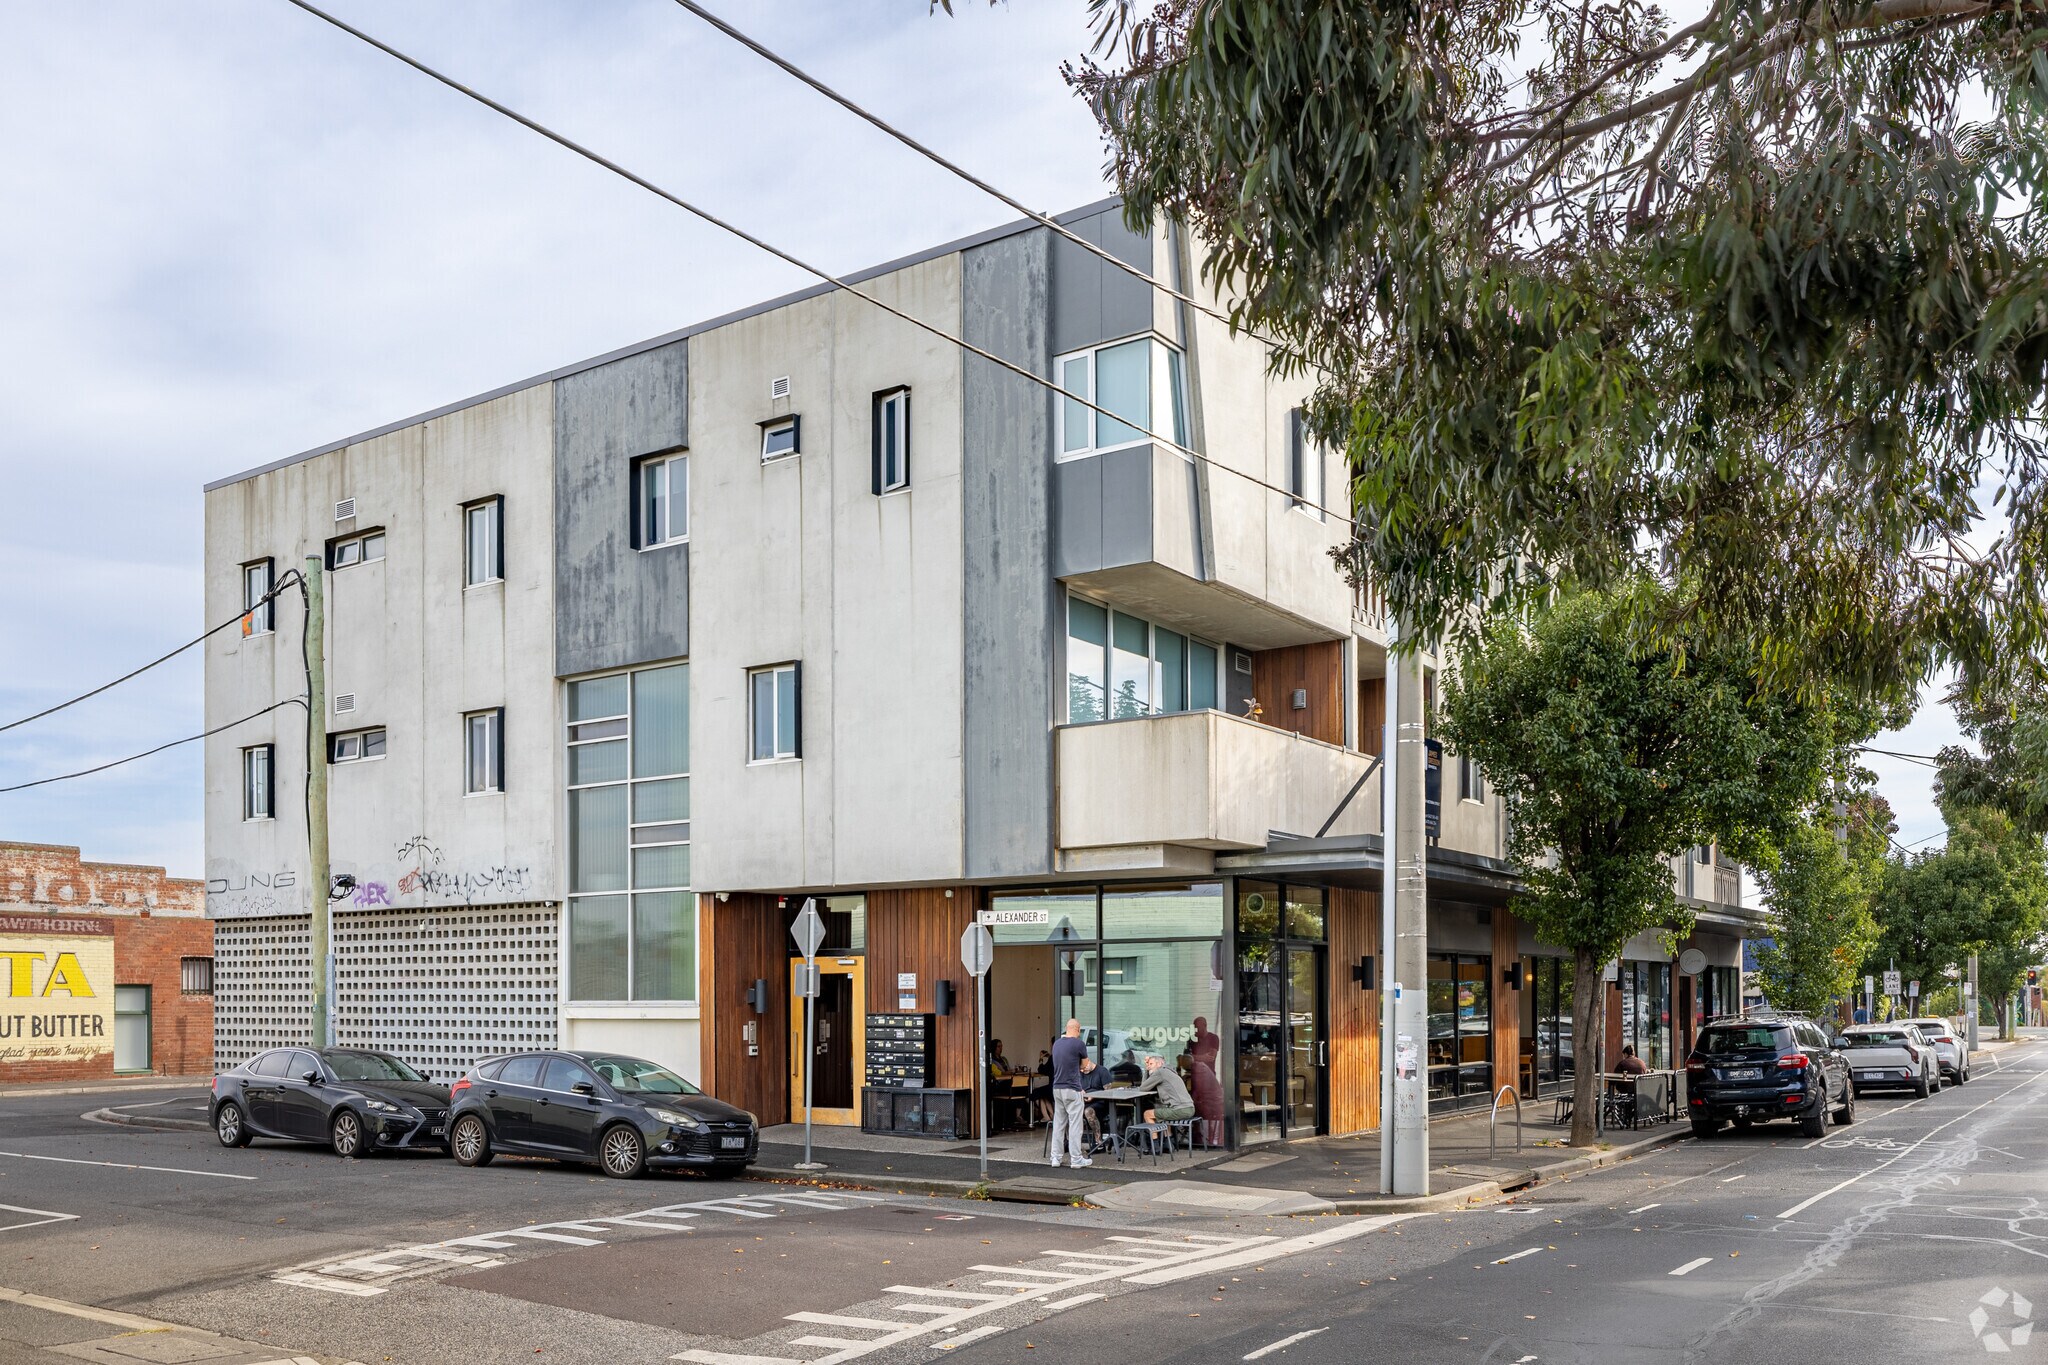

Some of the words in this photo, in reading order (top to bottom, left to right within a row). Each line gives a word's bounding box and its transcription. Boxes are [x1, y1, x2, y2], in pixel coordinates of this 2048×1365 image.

[996, 912, 1038, 923] ALEXANDER
[1040, 914, 1047, 922] ST
[0, 951, 97, 998] TA
[0, 1015, 25, 1038] UT
[31, 1014, 104, 1038] BUTTER
[1129, 1024, 1199, 1048] august
